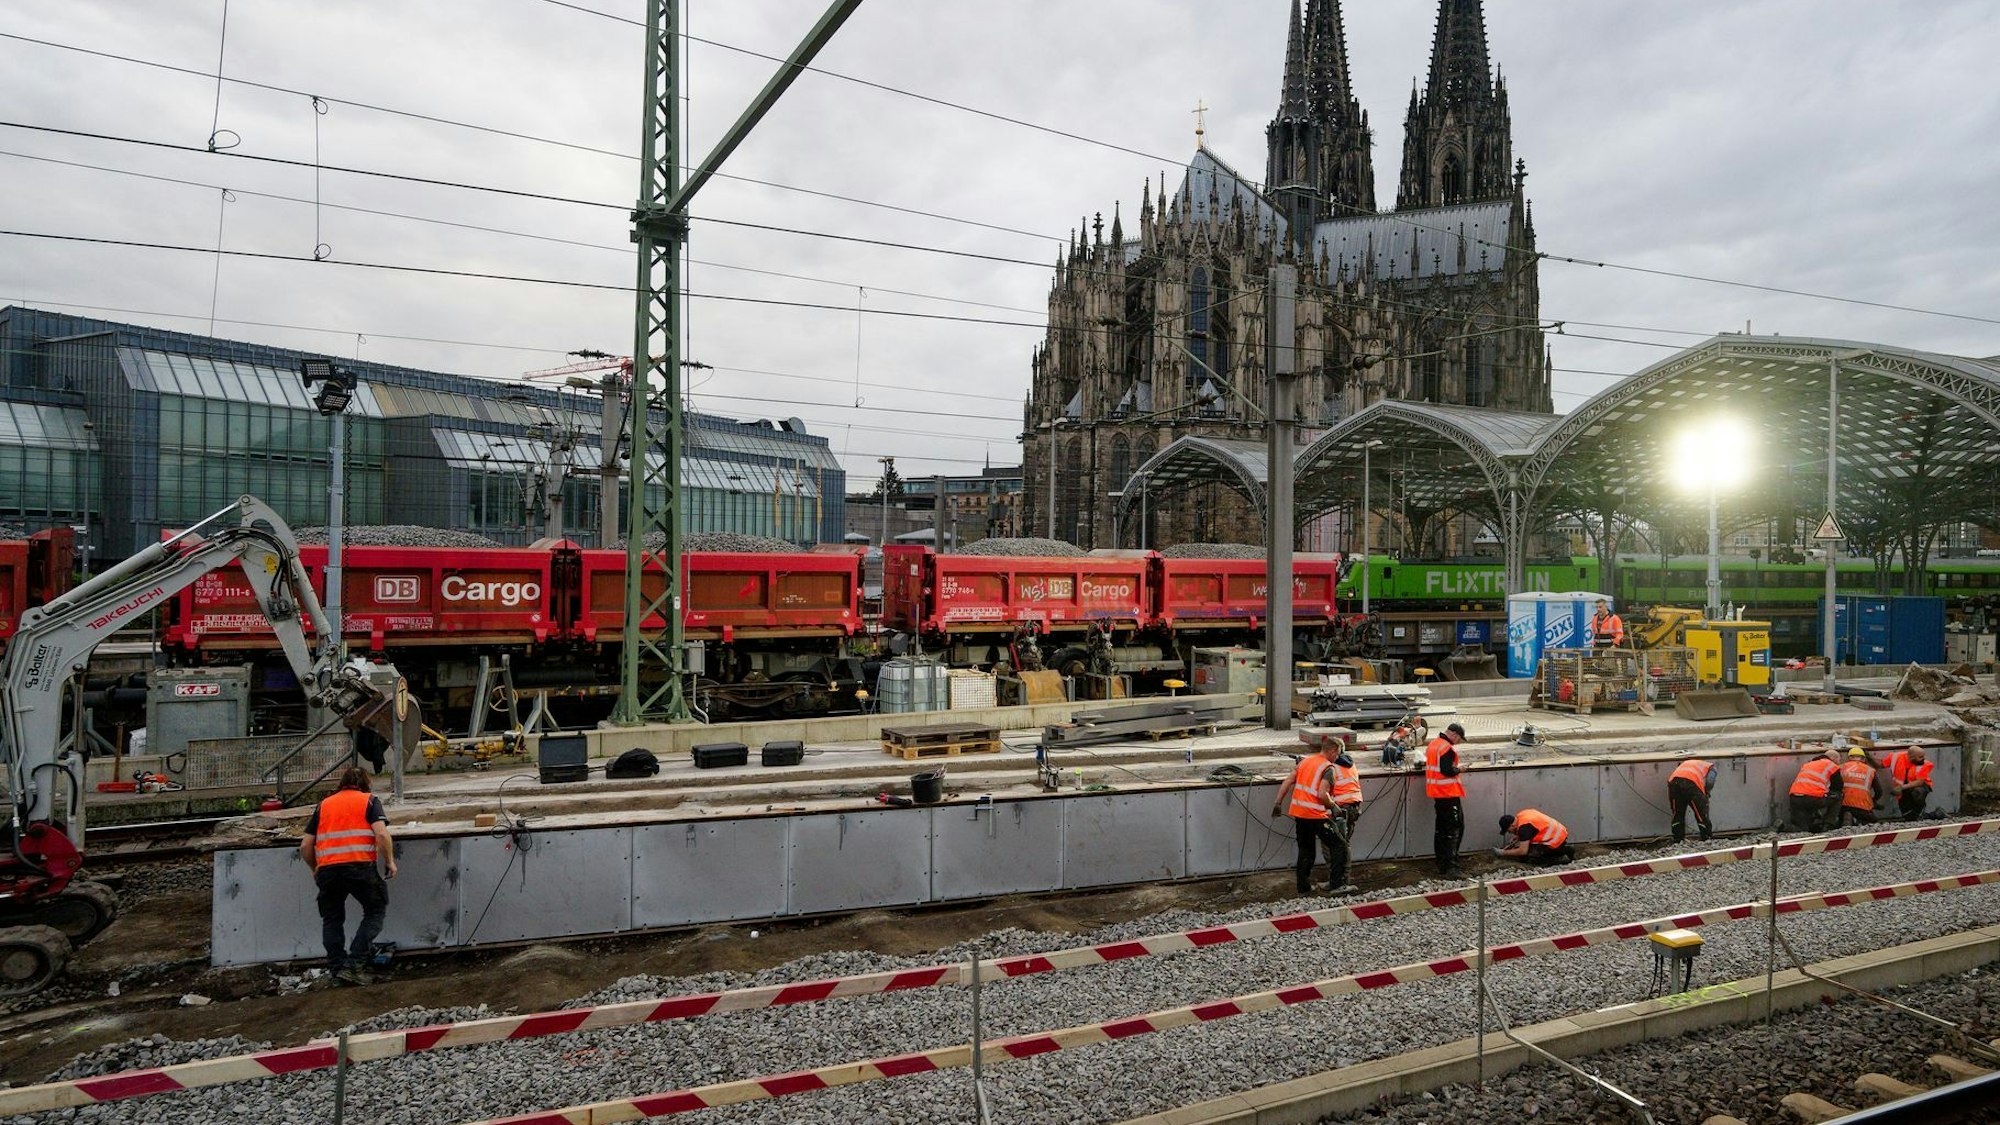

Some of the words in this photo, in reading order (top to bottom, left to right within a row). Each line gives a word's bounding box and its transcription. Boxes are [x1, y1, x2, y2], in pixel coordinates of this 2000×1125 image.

[380, 579, 416, 598] DB
[441, 576, 541, 606] Cargo
[1081, 582, 1130, 600] Cargo
[86, 587, 164, 630] TAKEUCHI
[28, 644, 47, 676] Balter
[1978, 750, 1994, 772] 7
